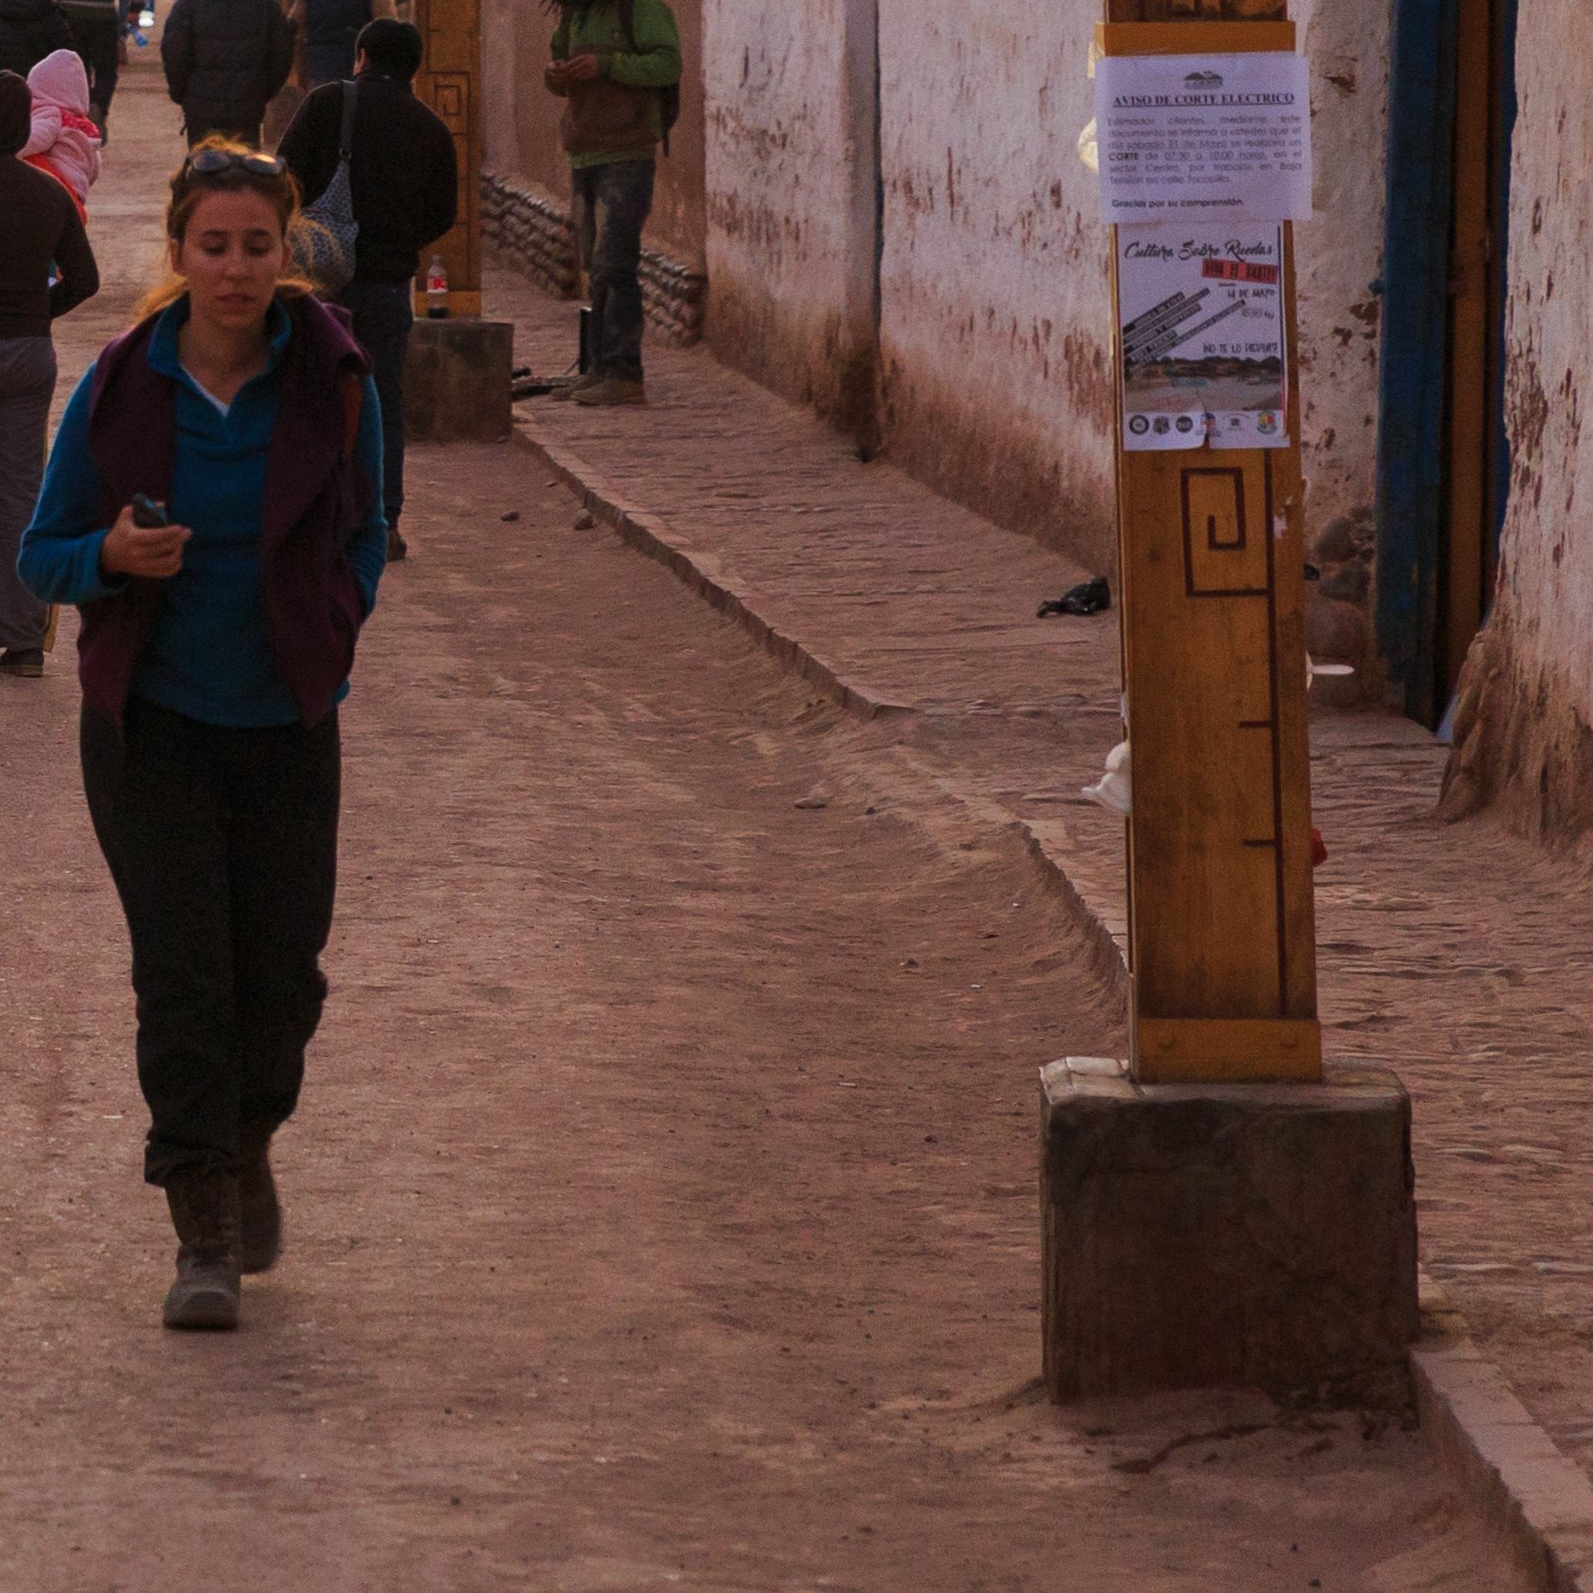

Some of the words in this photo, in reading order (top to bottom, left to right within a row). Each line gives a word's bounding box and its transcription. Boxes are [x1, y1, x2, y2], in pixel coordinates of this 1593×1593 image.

[1114, 95, 1152, 106] AVISO
[1155, 94, 1170, 105] DE
[1174, 94, 1215, 105] CORTE
[1222, 93, 1295, 105] ELECTRICO
[1108, 152, 1139, 161] CORTE
[1112, 198, 1146, 208] Gracias
[1148, 200, 1165, 209] por
[1167, 200, 1179, 208] su
[1124, 241, 1174, 262] Cultura
[1178, 240, 1220, 261] Sobre
[1224, 239, 1273, 262] Ruedas
